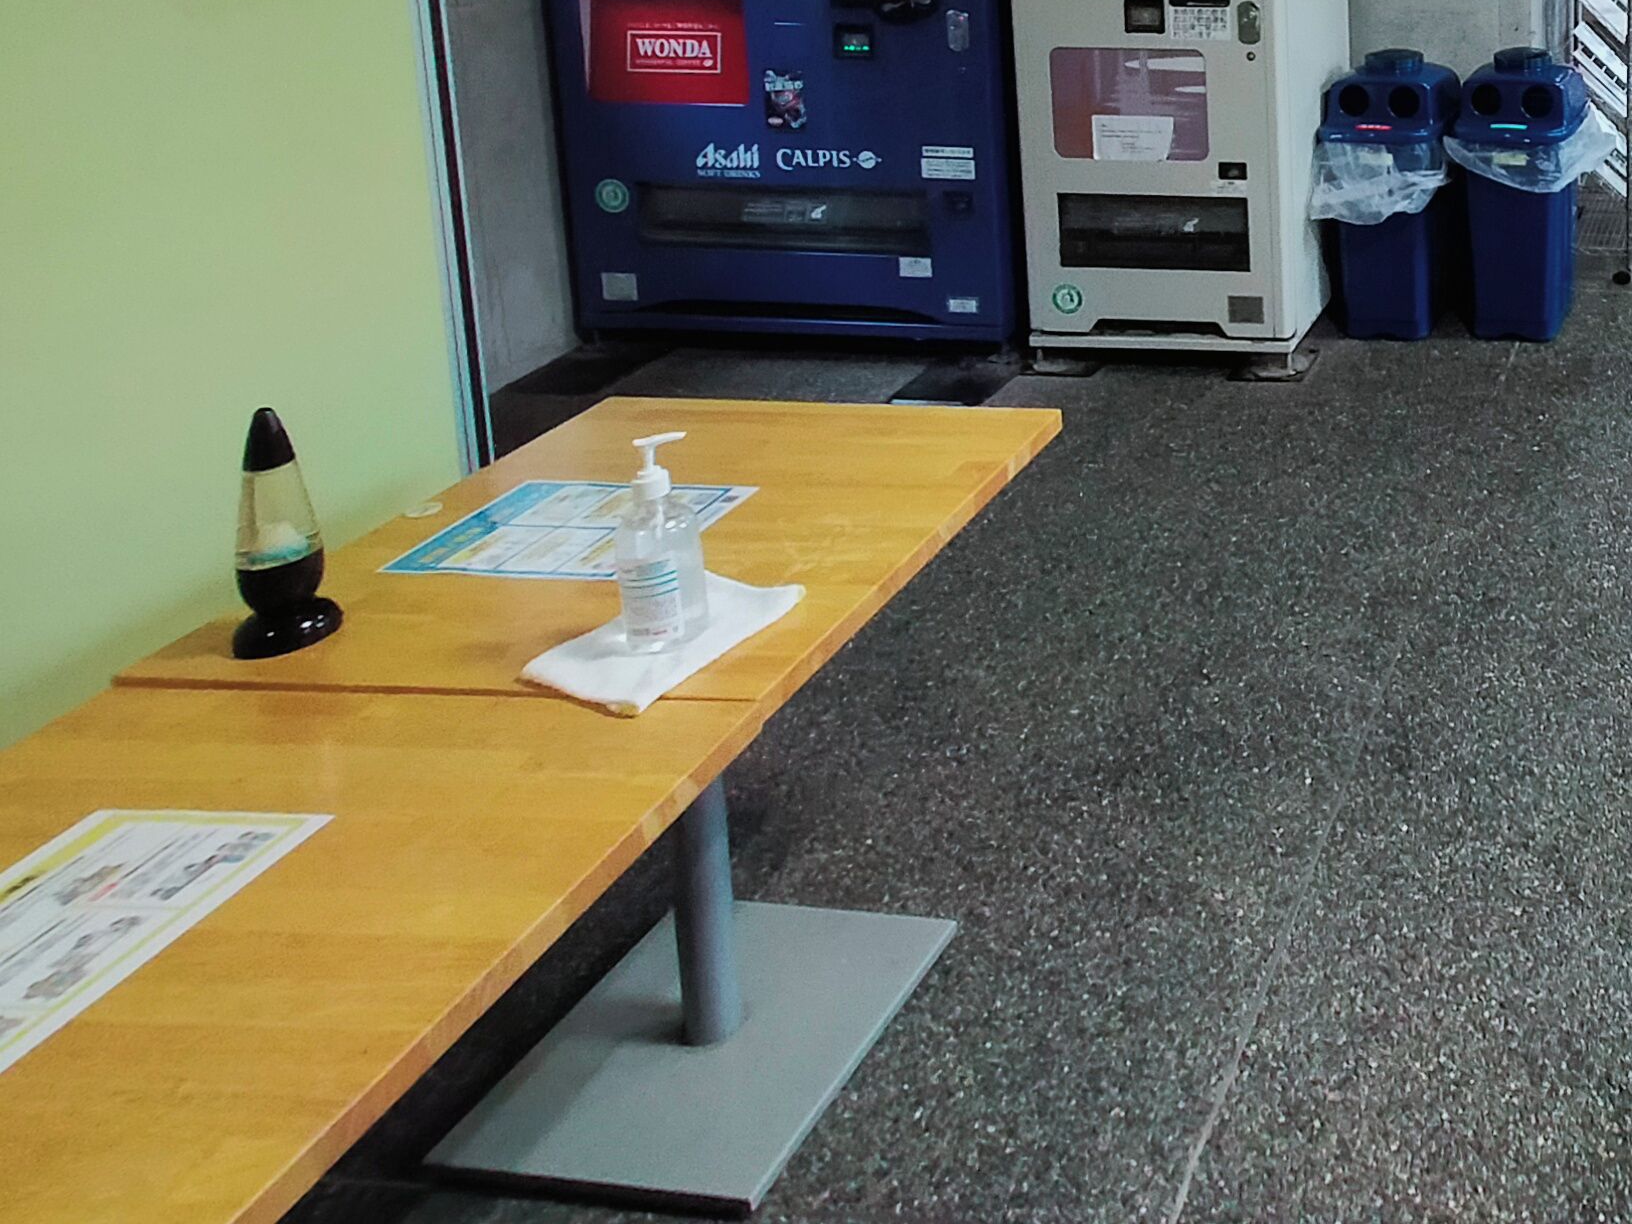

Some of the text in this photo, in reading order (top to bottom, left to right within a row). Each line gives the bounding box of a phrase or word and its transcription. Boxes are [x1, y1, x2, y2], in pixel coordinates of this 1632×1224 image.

[636, 38, 712, 58] WONDA
[696, 143, 851, 170] Asahi CALPIS
